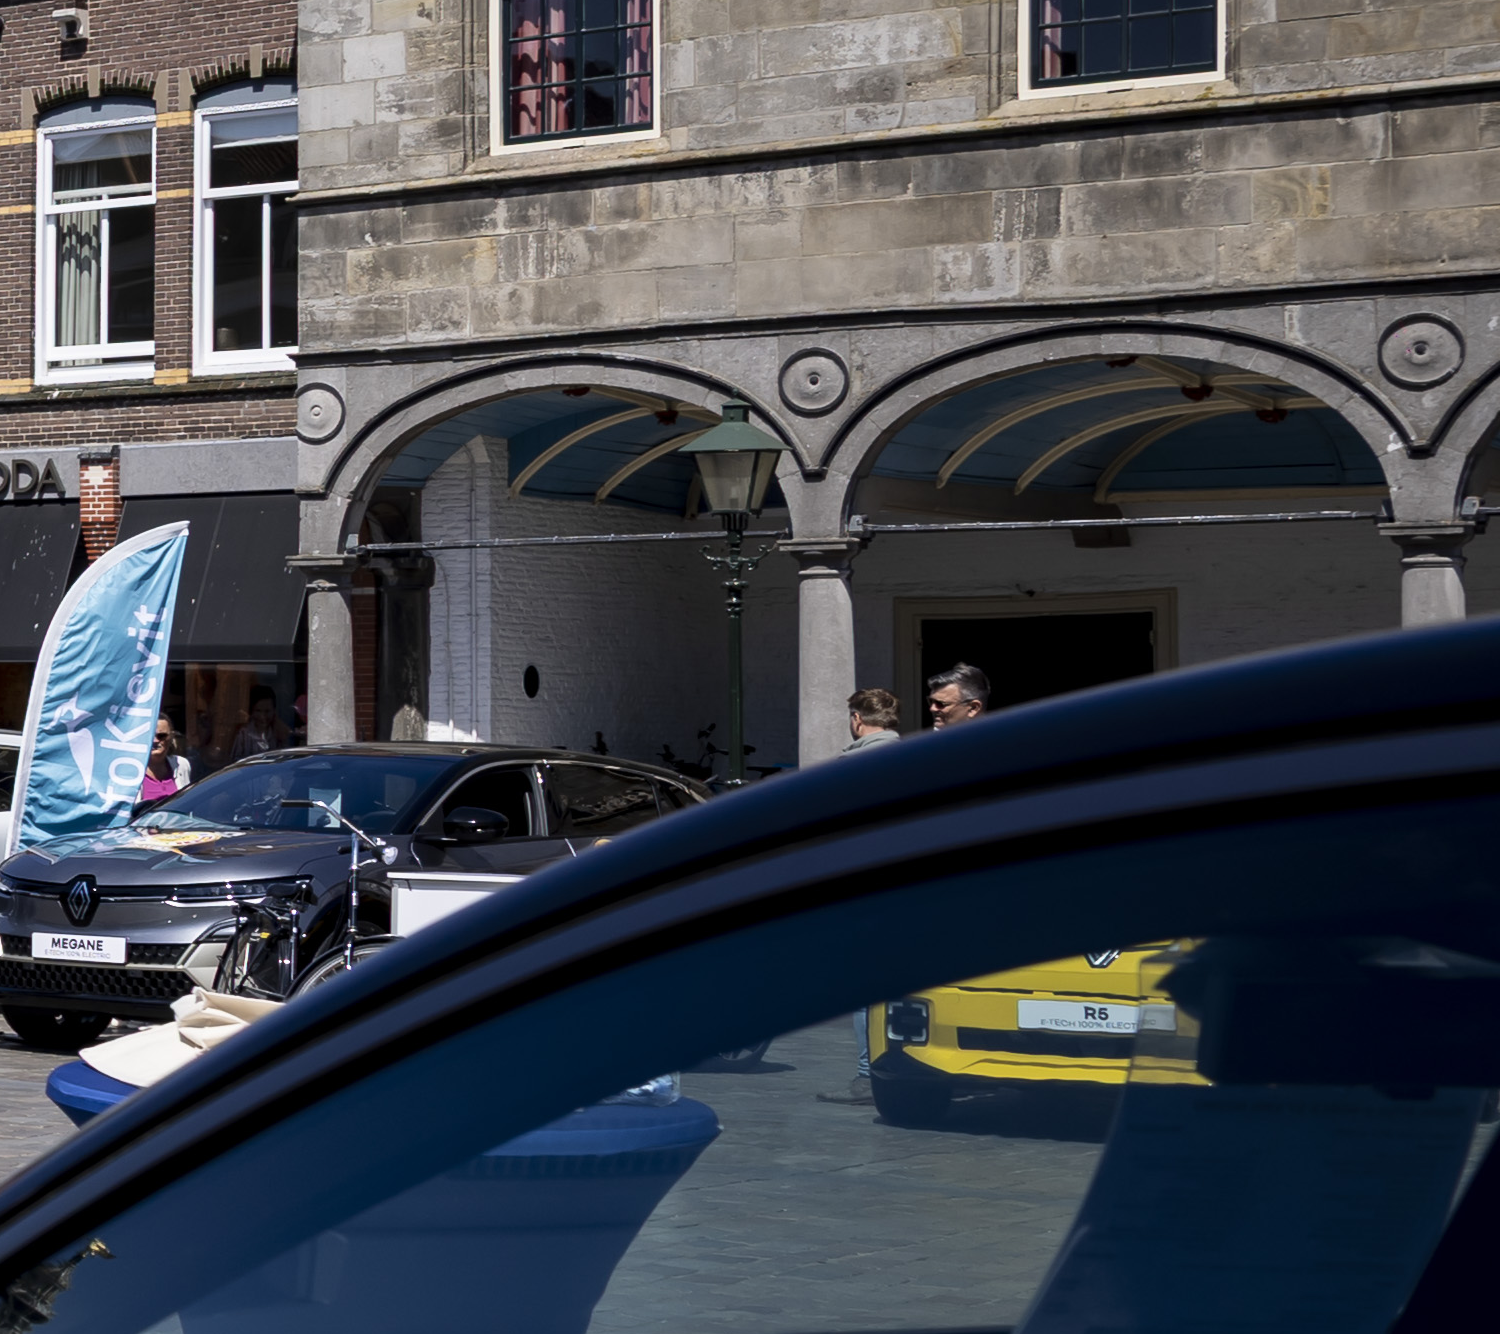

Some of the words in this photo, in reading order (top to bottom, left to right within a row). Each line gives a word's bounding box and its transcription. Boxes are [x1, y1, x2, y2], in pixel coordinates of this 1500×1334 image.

[51, 937, 104, 952] MEGANE
[1084, 1006, 1109, 1021] R5
[1040, 1018, 1077, 1027] E-TECH
[1078, 1020, 1104, 1029] 100%
